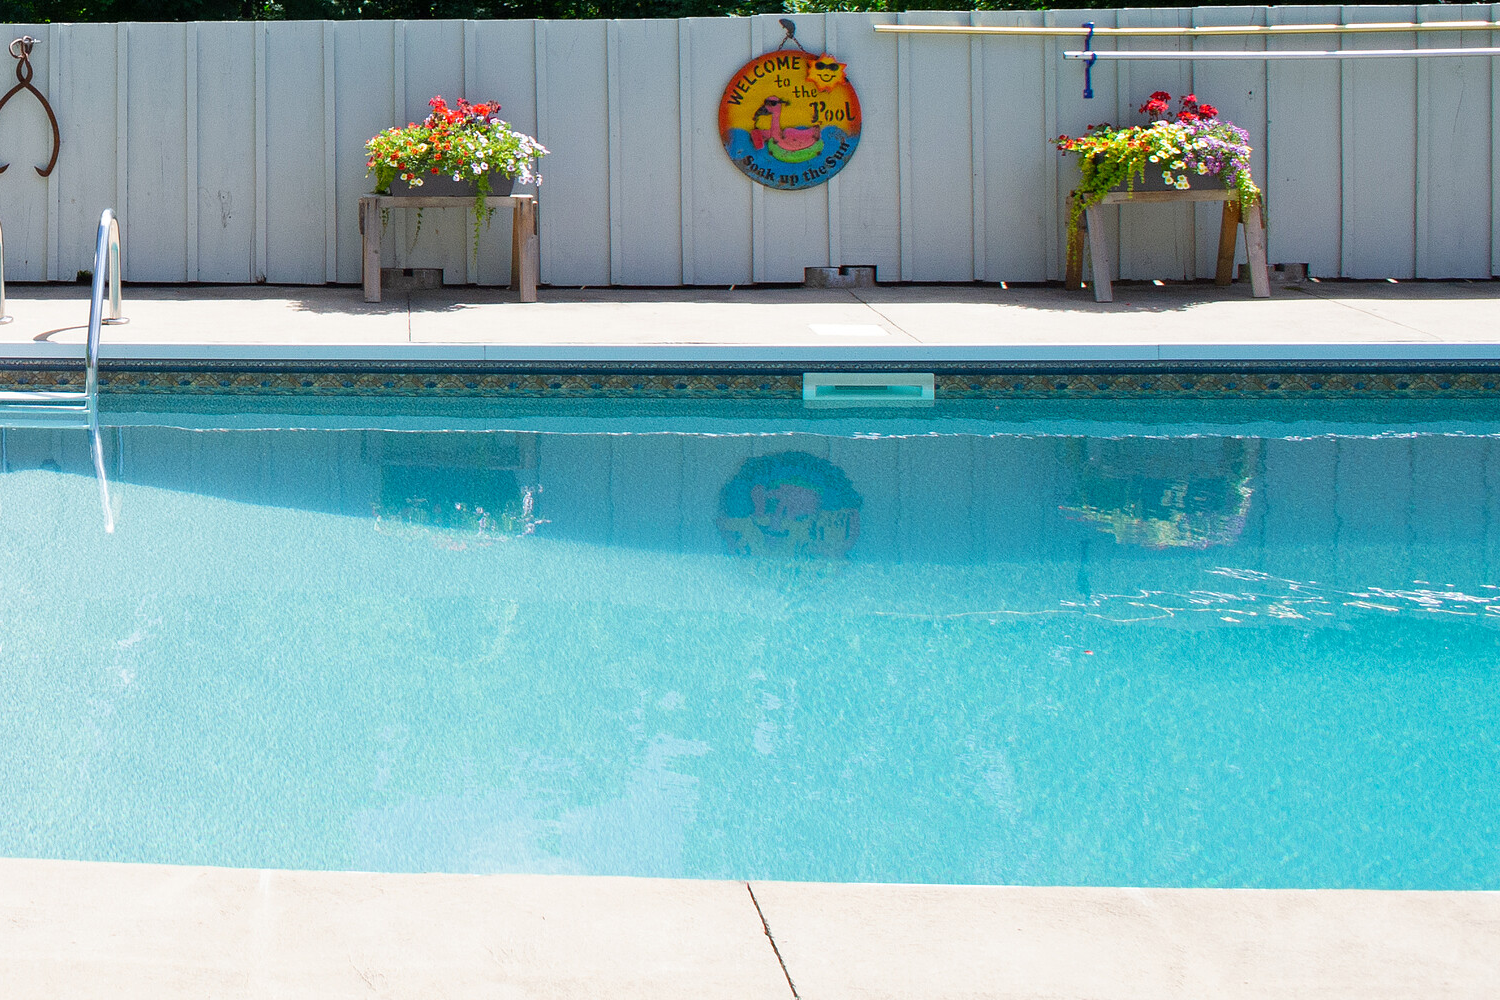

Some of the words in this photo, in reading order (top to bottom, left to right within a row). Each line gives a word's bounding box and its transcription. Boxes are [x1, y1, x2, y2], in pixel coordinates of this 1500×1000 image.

[727, 56, 801, 106] WELCOME
[774, 74, 791, 88] to
[792, 85, 818, 98] the
[809, 101, 856, 123] Pool
[742, 155, 775, 182] Soak
[779, 174, 799, 186] up
[802, 165, 827, 182] the
[825, 141, 850, 168] Sun
